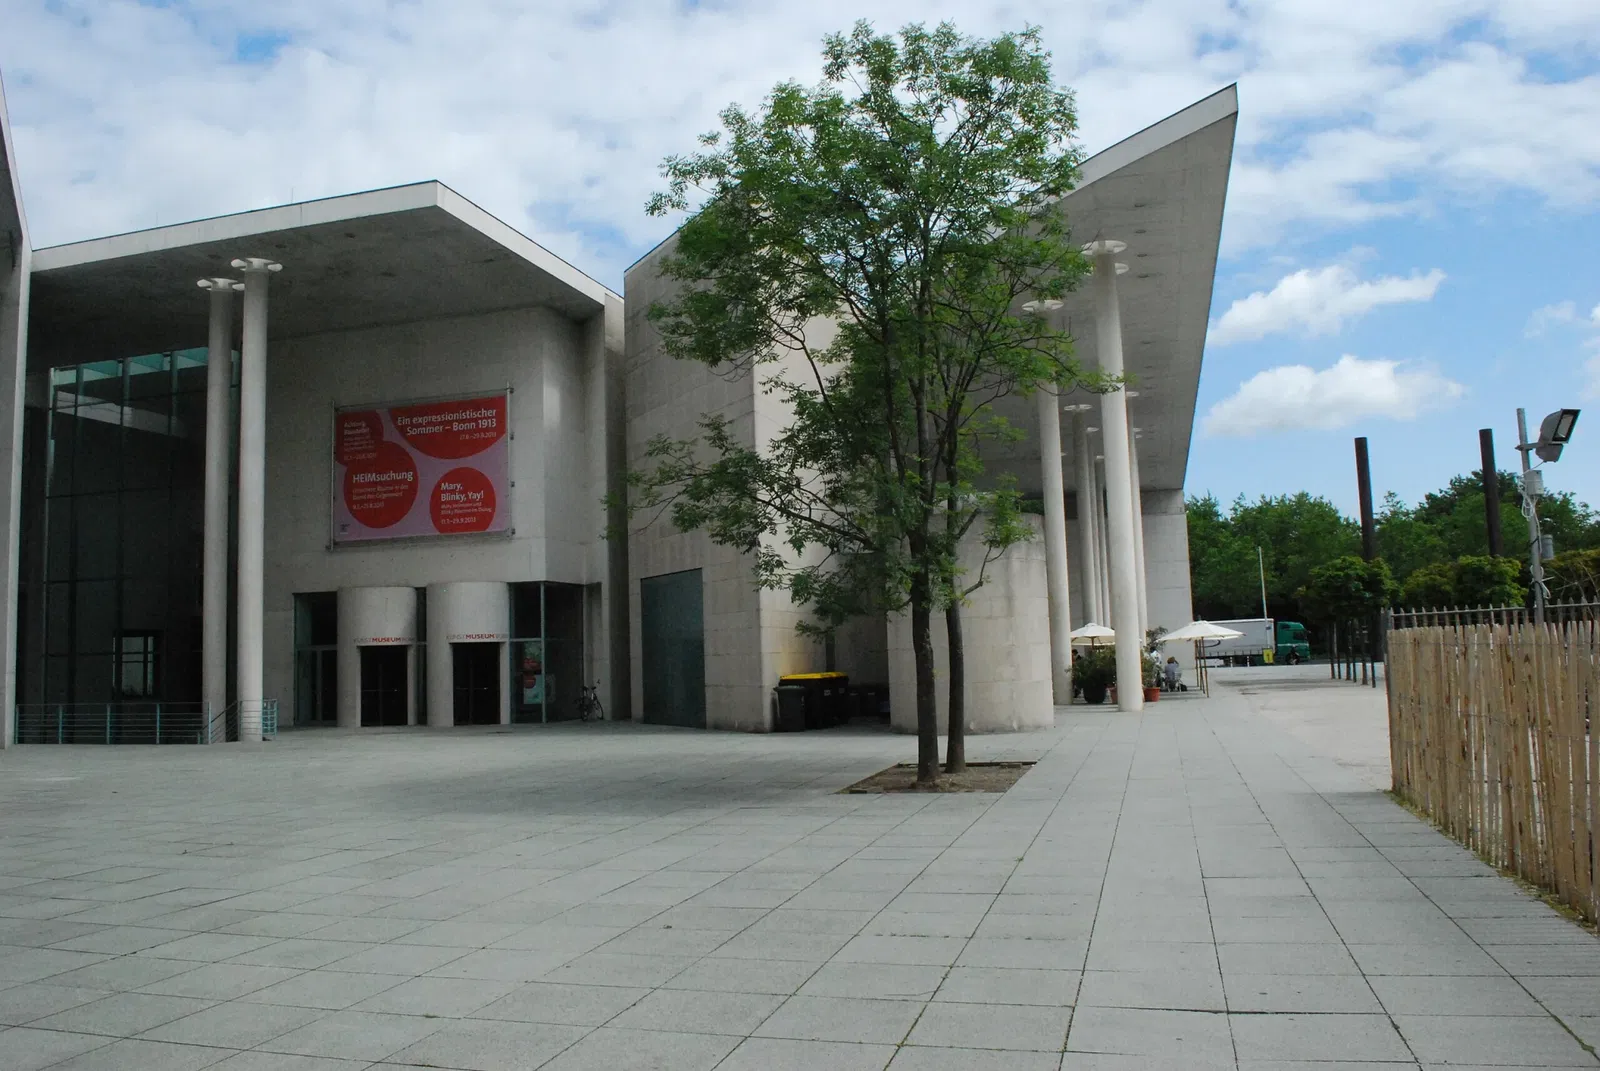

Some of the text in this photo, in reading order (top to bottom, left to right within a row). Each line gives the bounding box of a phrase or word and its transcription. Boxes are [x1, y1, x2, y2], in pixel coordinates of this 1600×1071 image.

[397, 408, 497, 426] Ein expressionistischer
[406, 425, 444, 436] Sommer
[452, 422, 476, 431] Bonn
[478, 418, 497, 429] 1913
[352, 470, 414, 483] HEIMsuchung
[440, 490, 484, 502] Blinky, Yay!
